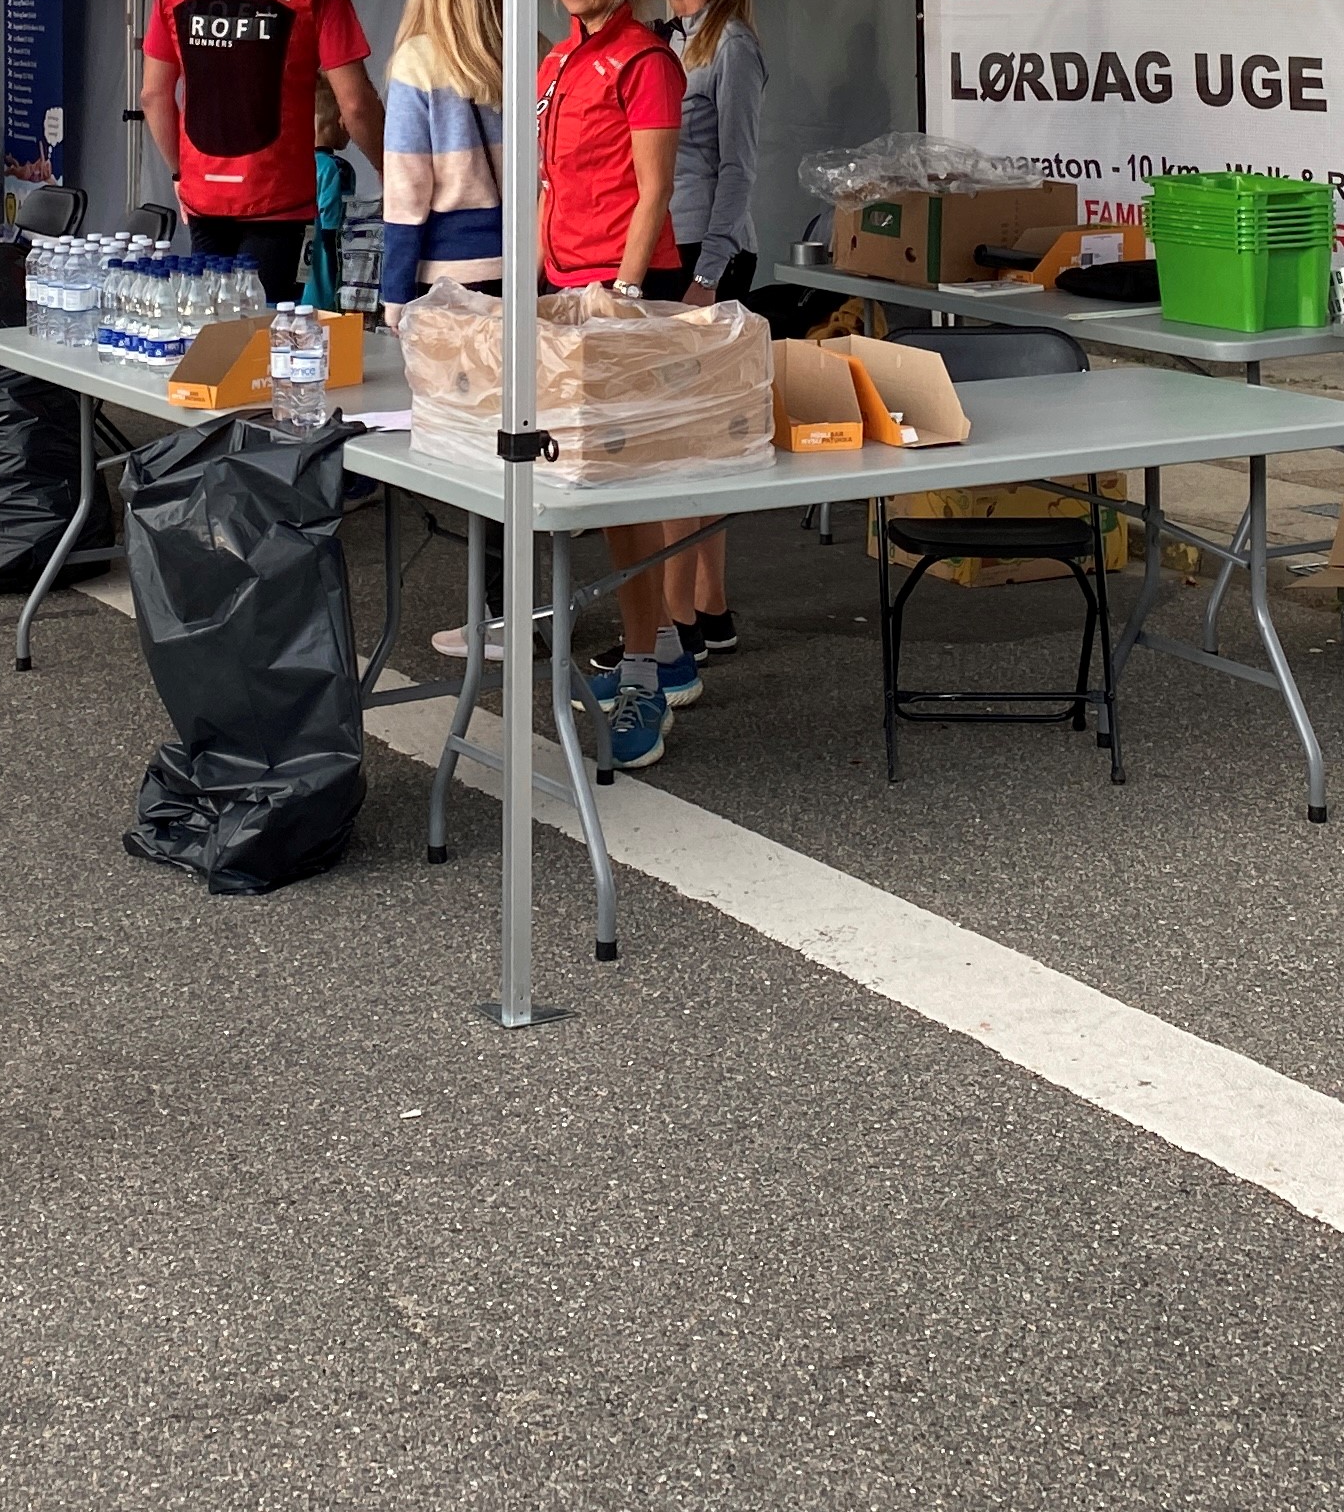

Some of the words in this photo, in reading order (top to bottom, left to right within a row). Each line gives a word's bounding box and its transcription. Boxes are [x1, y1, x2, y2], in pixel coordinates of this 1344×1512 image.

[191, 15, 271, 40] ROFL
[188, 37, 233, 48] RUNNERS
[949, 49, 1173, 104] LØRDAG
[1194, 52, 1329, 113] UGE
[1127, 154, 1153, 181] 10
